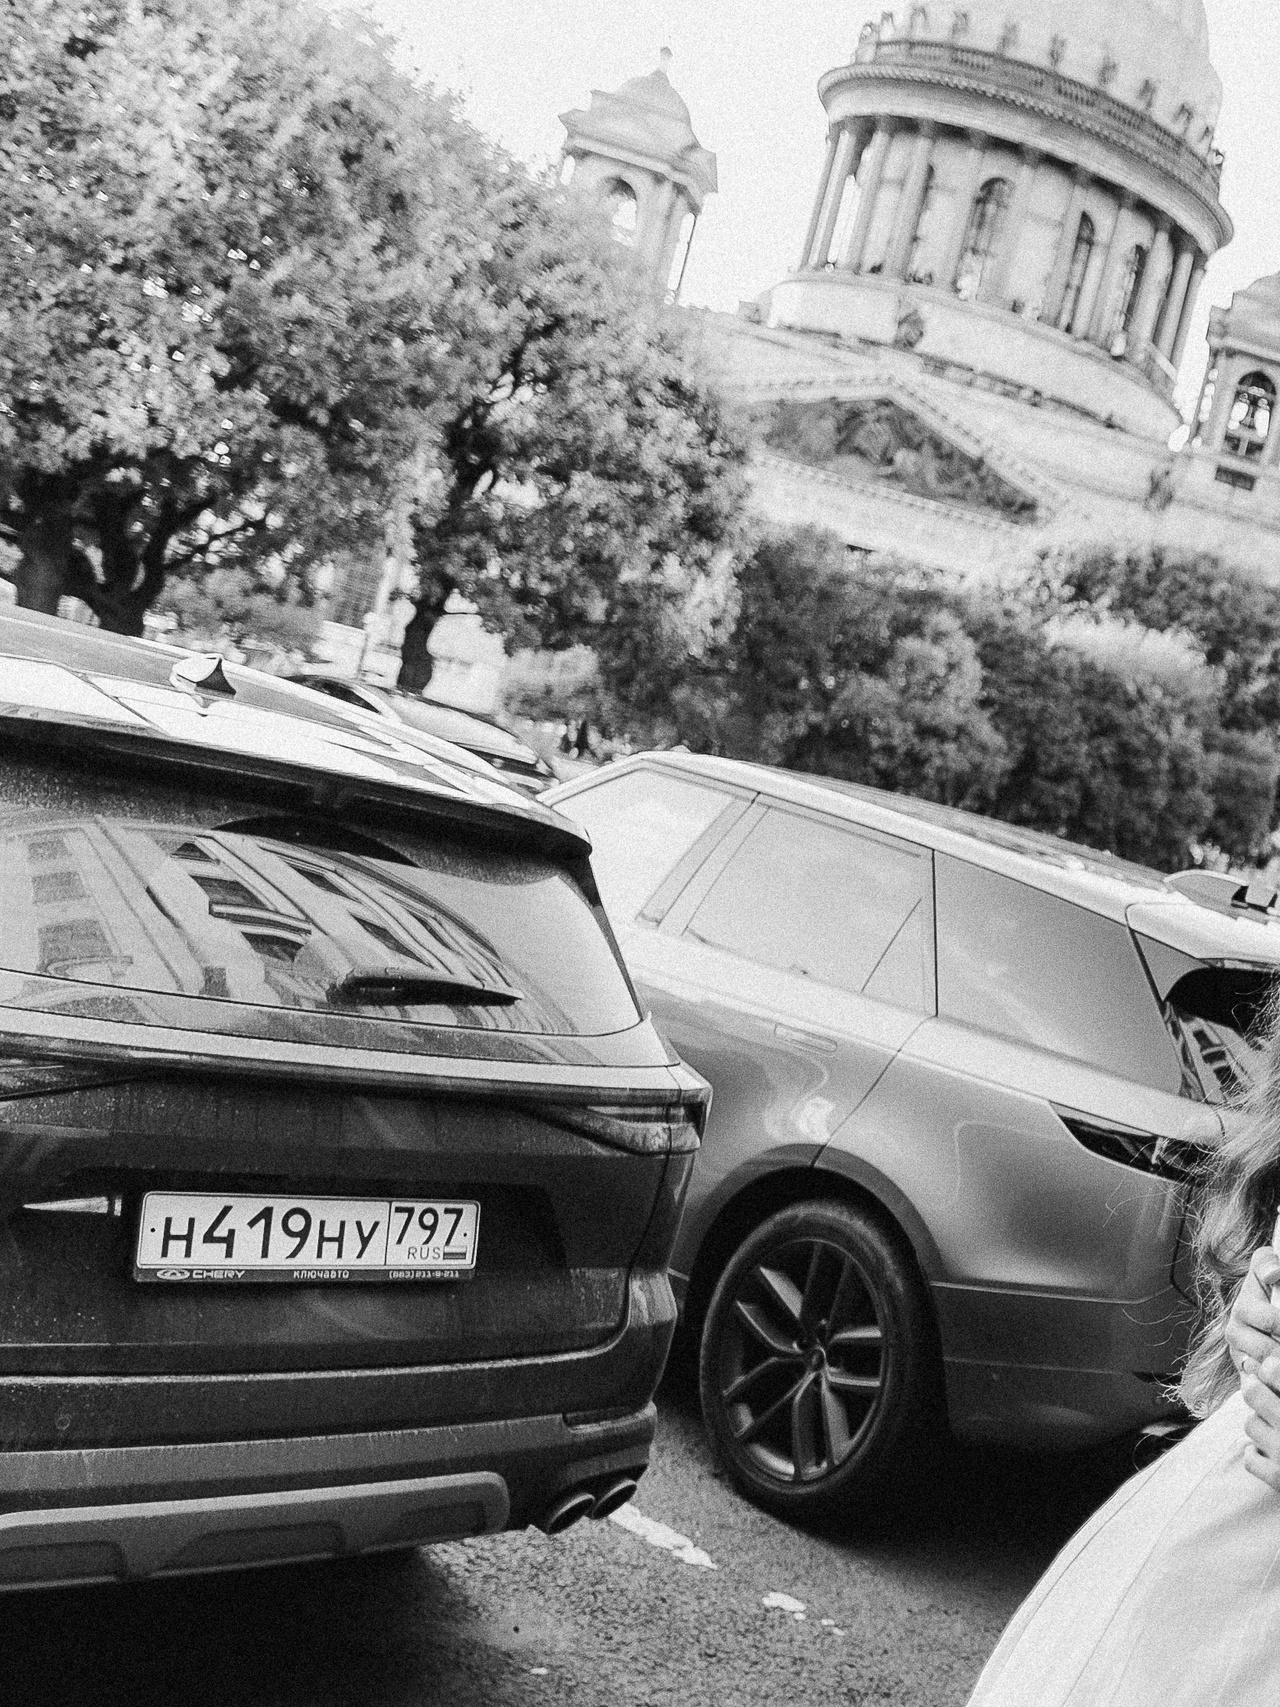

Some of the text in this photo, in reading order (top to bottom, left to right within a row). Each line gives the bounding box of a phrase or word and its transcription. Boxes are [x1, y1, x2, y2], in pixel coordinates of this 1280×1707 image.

[161, 1205, 463, 1260] Н419НУ 797
[407, 1246, 441, 1260] RUS
[192, 1269, 246, 1279] CHERY
